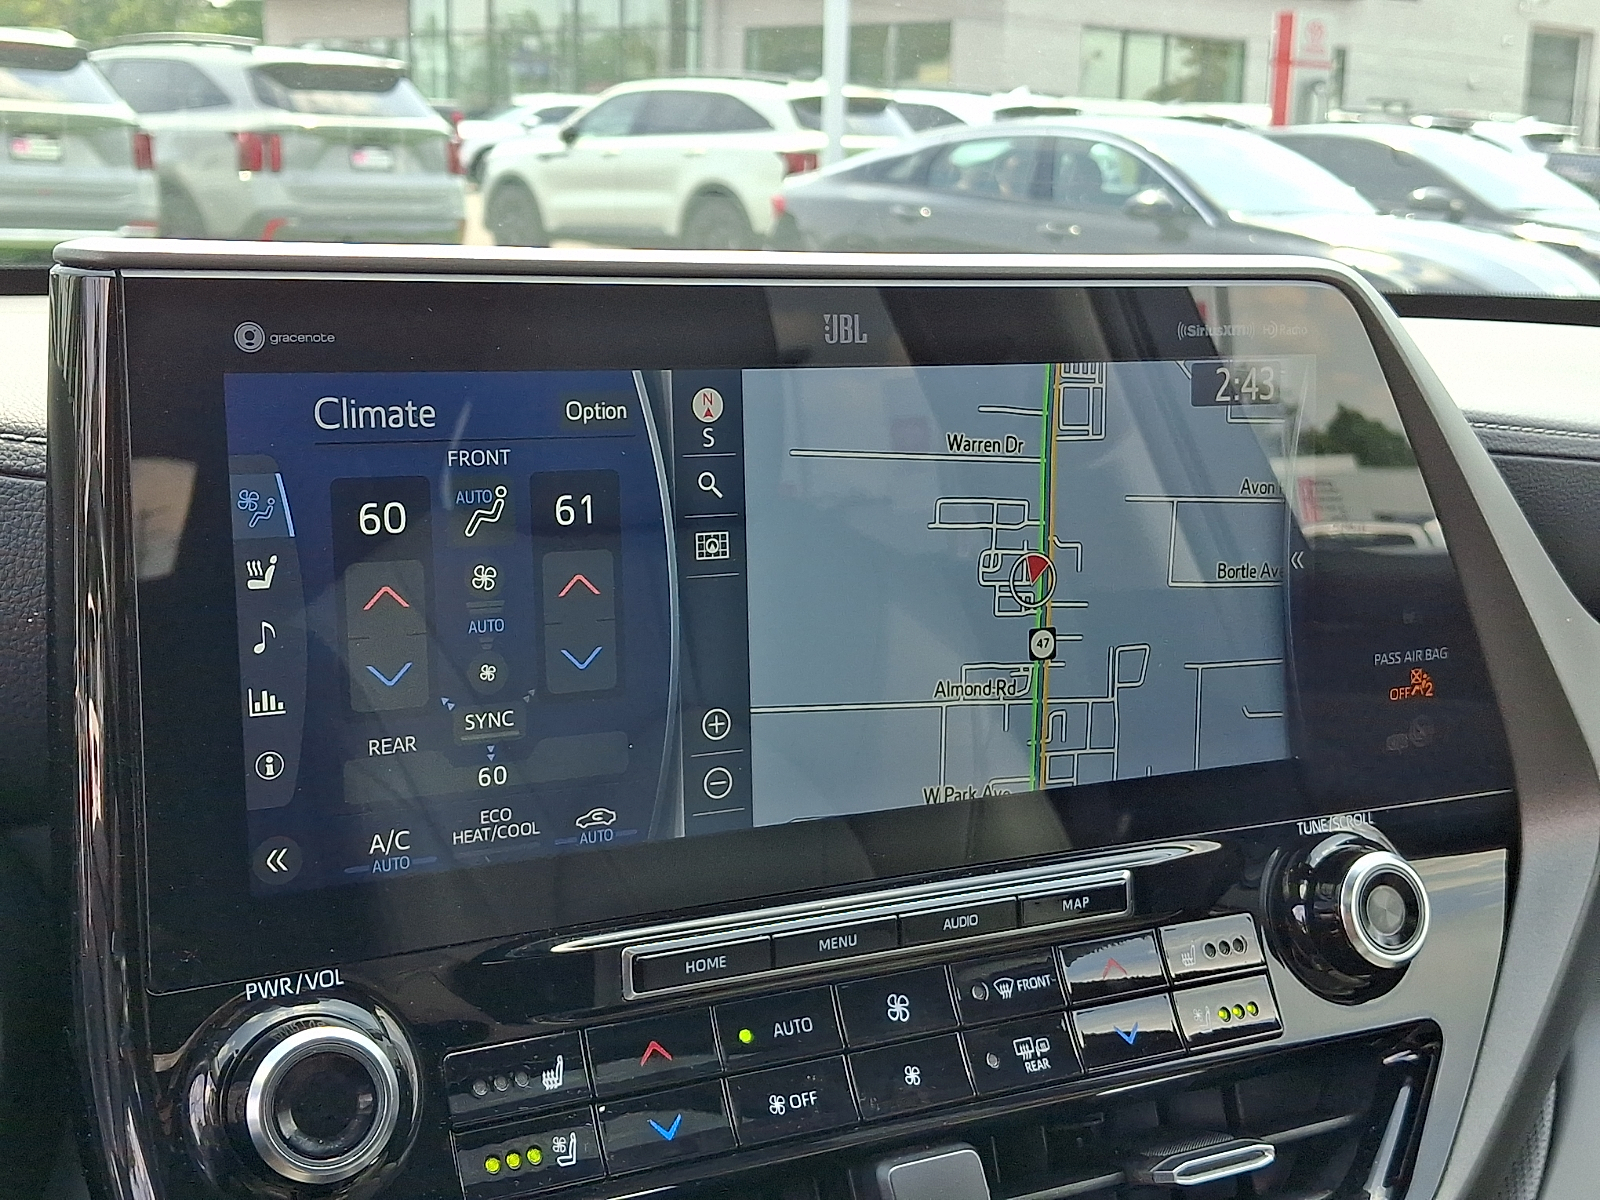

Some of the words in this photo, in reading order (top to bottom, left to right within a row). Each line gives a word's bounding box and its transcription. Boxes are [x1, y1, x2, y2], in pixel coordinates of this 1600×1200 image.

[269, 332, 336, 345] gracenote
[824, 314, 868, 344] JBL
[1215, 366, 1275, 402] 2:43
[702, 393, 714, 406] N
[313, 396, 437, 431] Climate
[565, 400, 628, 424] Option
[702, 428, 716, 448] S
[947, 433, 1000, 453] Warren
[1005, 436, 1024, 454] Dr
[447, 449, 511, 468] FRONT
[1240, 478, 1276, 495] Avon
[455, 489, 493, 505] AUTO
[358, 502, 407, 536] 60
[554, 494, 594, 526] 61
[1217, 562, 1257, 579] Bortle
[467, 618, 505, 634] AUTO
[1035, 637, 1050, 650] 47
[1374, 652, 1401, 666] PASS
[1404, 650, 1423, 663] AIR
[1425, 647, 1449, 661] BAG
[933, 679, 992, 698] Almond
[996, 679, 1017, 696] Rd
[1389, 687, 1410, 701] OFF
[464, 710, 515, 731] SYNC
[367, 735, 417, 757] REAR
[477, 766, 508, 788] 60
[923, 786, 940, 804] W
[944, 785, 978, 803] Park
[480, 807, 513, 824] ECO
[1296, 811, 1376, 836] TUNE/SCROLL
[369, 830, 411, 855] A/C
[452, 820, 541, 846] HEAT/COOL
[579, 829, 613, 844] AUTO
[371, 856, 411, 874] AUTO
[1062, 896, 1091, 912] MAP
[942, 913, 980, 932] AUDIO
[817, 932, 859, 952] MENU
[684, 954, 728, 973] HOME
[245, 968, 345, 1001] PWR/VOL
[1016, 974, 1053, 991] FRONT
[772, 1016, 814, 1038] AUTO
[1024, 1057, 1052, 1073] REAR
[788, 1091, 819, 1110] OFF
